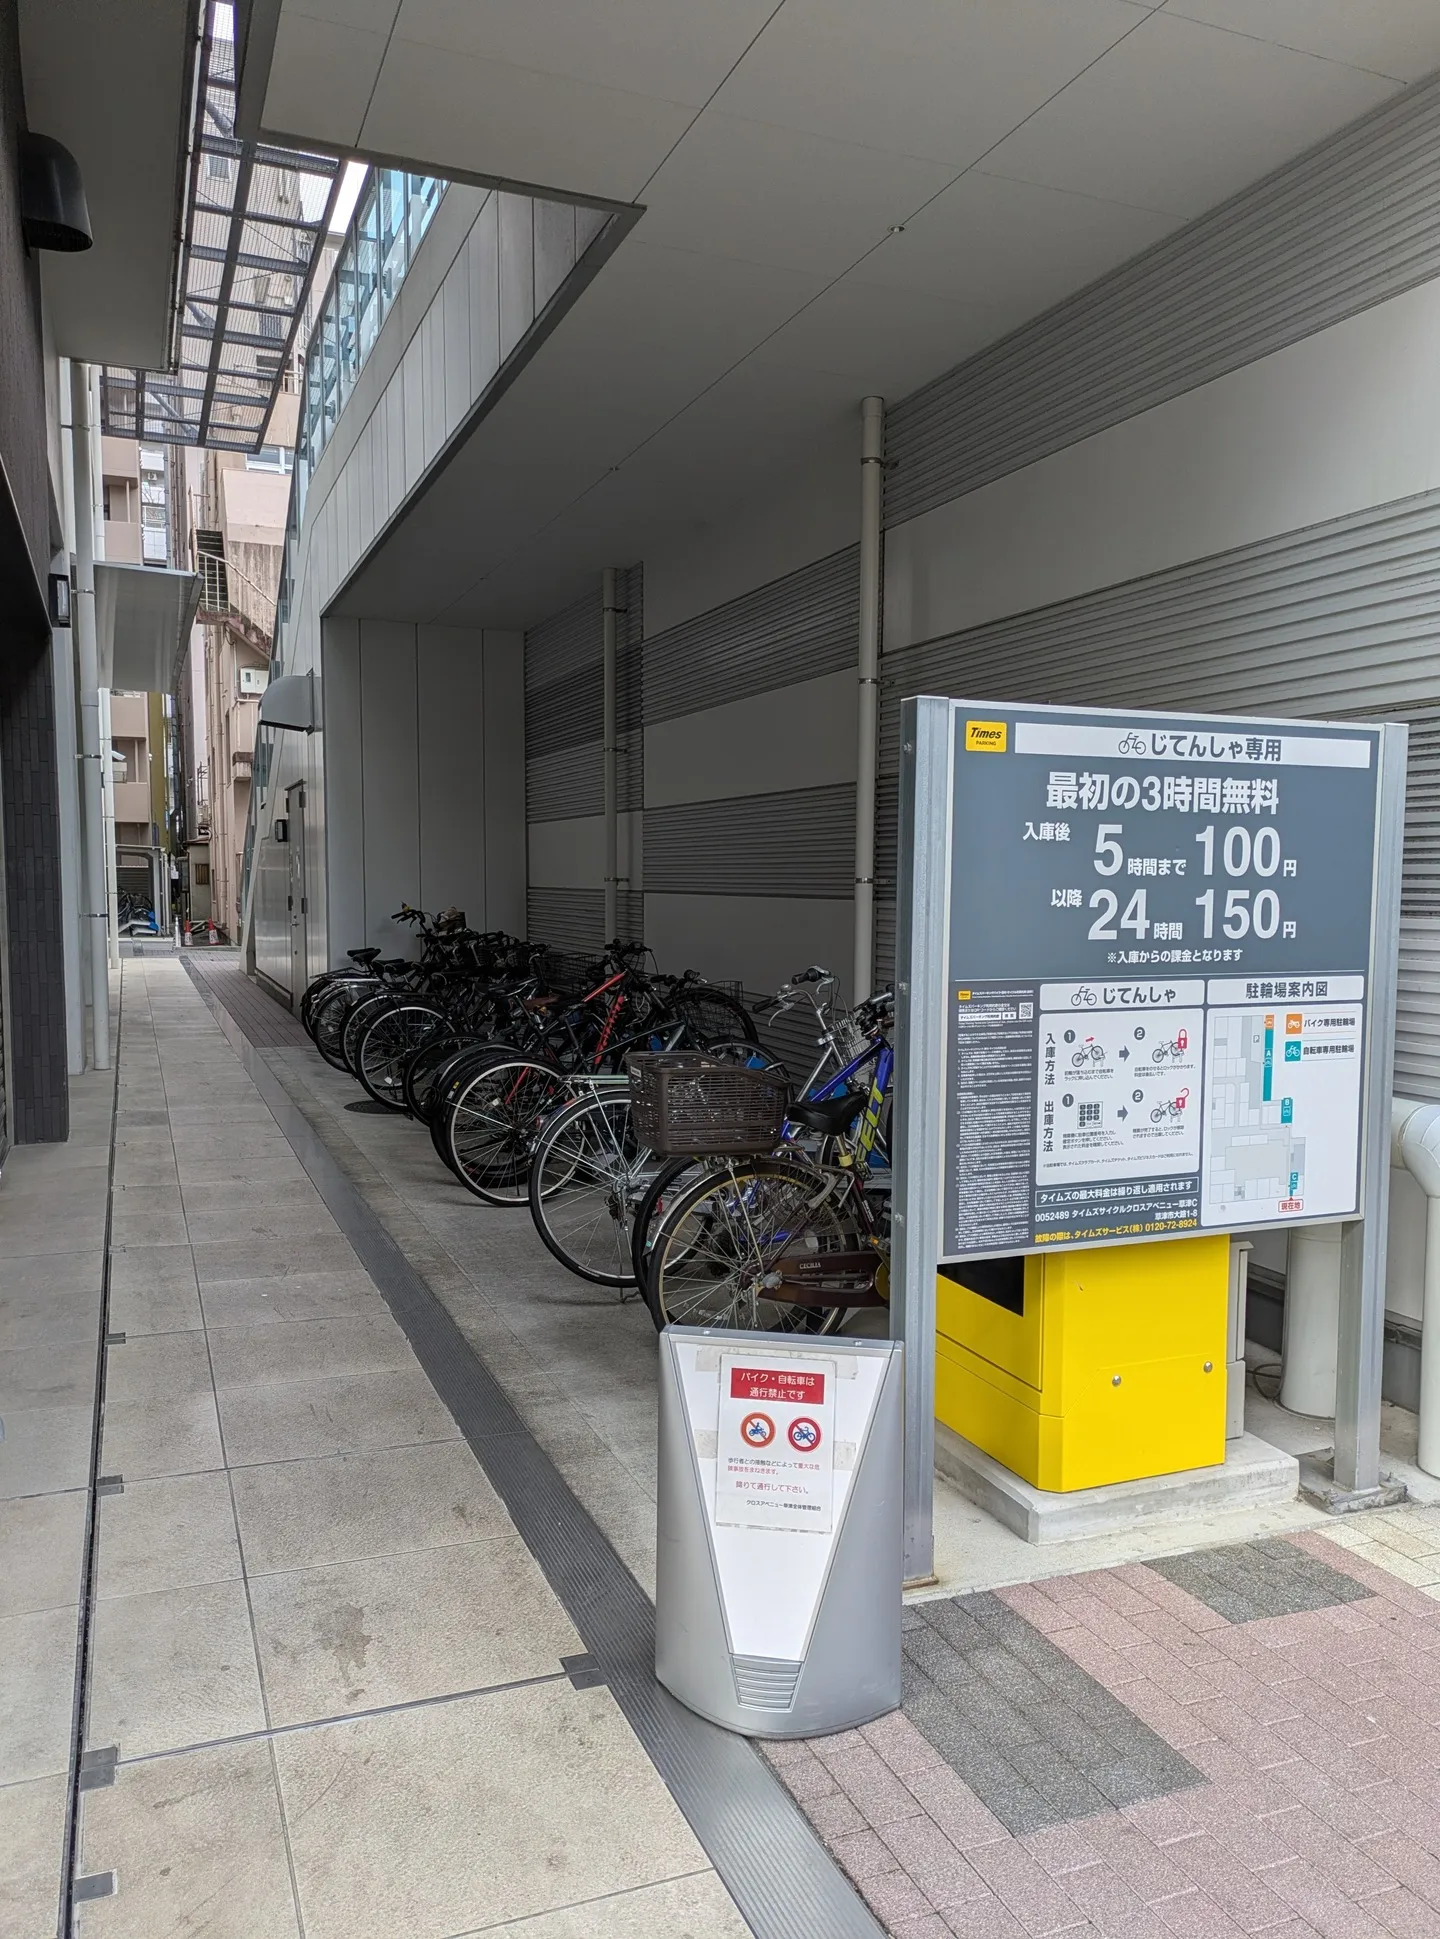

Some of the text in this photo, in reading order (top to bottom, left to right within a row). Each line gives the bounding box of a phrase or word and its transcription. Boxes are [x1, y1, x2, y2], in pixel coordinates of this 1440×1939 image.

[970, 727, 1002, 739] Times
[1151, 733, 1281, 761] じてんしゃ専用
[1046, 771, 1279, 815] 最初の3時間無料
[1022, 822, 1071, 841] 入庫後
[1093, 824, 1297, 877] 5 時間まで 100 円
[1050, 889, 1083, 908] 以降
[1087, 888, 1296, 940] 24 時間 150 円
[1107, 949, 1243, 964] ※入庫からの課金となります
[1103, 986, 1176, 1005] じてんしゃ
[1245, 981, 1328, 999] 駐輪場案内図
[1304, 1018, 1356, 1028] バイク専用駐輪場
[1044, 1033, 1056, 1085] 入庫方法
[1303, 1044, 1355, 1056] 自転車専用駐輪場
[1043, 1101, 1054, 1152] 出庫方法
[1040, 1181, 1193, 1204] タイムズの最大料金は繰り返し適用されます
[1281, 1201, 1301, 1210] 現在地
[1035, 1211, 1070, 1222] 0052489
[1145, 1219, 1198, 1232] 0120-72-8924
[740, 1372, 815, 1386] バイク・自転車は
[749, 1387, 806, 1401] 通行禁止です
[735, 1480, 809, 1494] 降りて通行して下さい。
